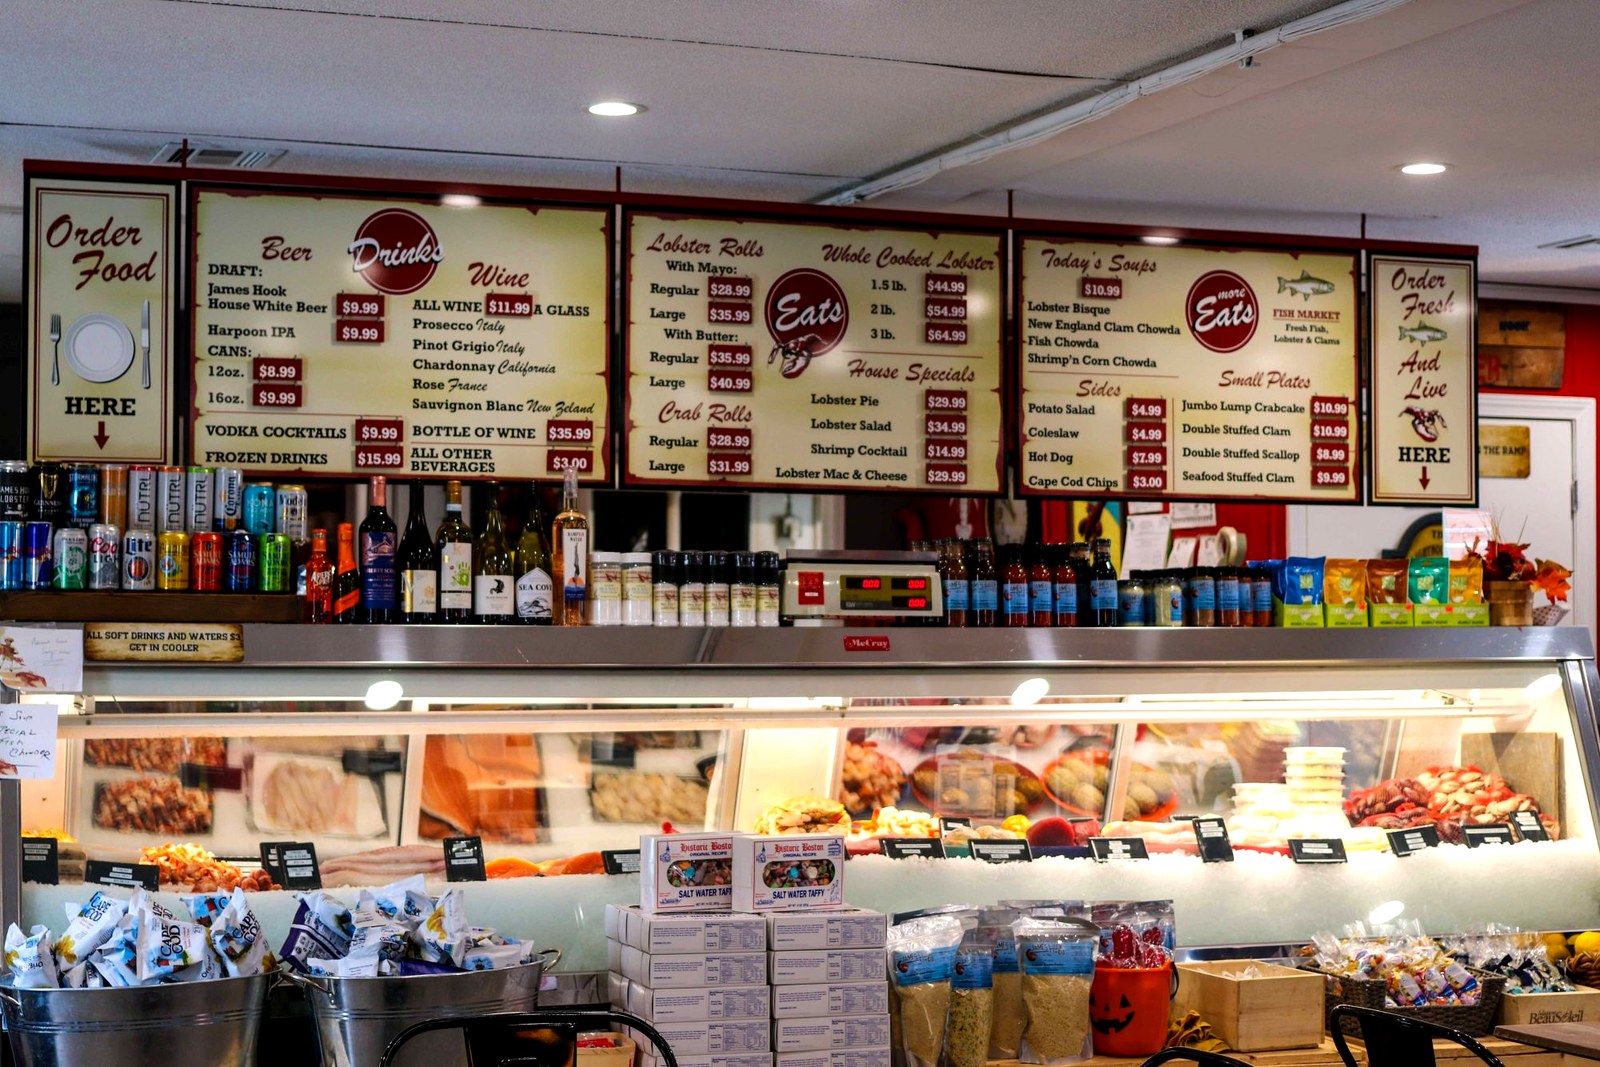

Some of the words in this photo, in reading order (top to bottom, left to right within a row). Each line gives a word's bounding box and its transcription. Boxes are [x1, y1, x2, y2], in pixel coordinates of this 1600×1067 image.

[46, 214, 142, 248] Order
[261, 236, 312, 261] Beer
[348, 232, 446, 272] Drinks
[647, 233, 711, 254] Lobster
[719, 238, 764, 257] Rolls
[822, 245, 871, 264] Whole
[877, 247, 932, 268] Cooked
[937, 251, 996, 270] Lobster
[1041, 249, 1101, 273] Today's
[1109, 254, 1157, 276] Soups
[72, 251, 157, 290] Food
[208, 264, 262, 277] DRAFT:
[468, 262, 529, 288] Wine
[666, 260, 694, 273] With
[698, 263, 737, 276] Mayo:
[1391, 267, 1446, 291] Order
[208, 284, 248, 297] James
[253, 284, 286, 296] Hook
[650, 283, 699, 296] Regular
[711, 284, 750, 296] $28.99
[927, 281, 965, 292] $44.99
[1085, 284, 1120, 296] $10.99
[1218, 287, 1246, 300] more
[208, 299, 250, 312] House
[253, 300, 291, 312] White
[343, 301, 378, 315] $9.99
[444, 301, 482, 312] WINE
[489, 301, 530, 315] $11.99
[547, 305, 589, 317] GLASS
[775, 293, 843, 332] Eats
[1028, 302, 1069, 313] Lobster
[1073, 303, 1110, 316] Bisque
[1401, 291, 1455, 321] Fresh
[650, 308, 686, 321] Large
[710, 309, 750, 321] $35.99
[1195, 296, 1255, 333] Eats
[1273, 309, 1294, 318] FISH
[1298, 310, 1340, 319] MARKET
[208, 325, 268, 339] Harpoon
[271, 326, 295, 338] IPA
[413, 319, 473, 331] Prosecco
[476, 318, 505, 334] Italy
[1028, 319, 1053, 330] New
[1056, 320, 1101, 333] England
[1104, 322, 1134, 333] Clam
[1137, 324, 1180, 335] Chowda
[1286, 324, 1307, 332] Fresh
[1310, 324, 1328, 334] Fish,
[696, 330, 738, 343] Butter:
[1028, 336, 1051, 346] Fish
[1274, 335, 1303, 344] Lobster
[1315, 337, 1340, 345] Clams
[208, 345, 252, 358] CANS:
[413, 340, 448, 351] Pinot
[452, 341, 495, 354] Grigio
[413, 359, 495, 374] Chardonnay
[498, 360, 556, 376] California
[1082, 356, 1110, 366] Corn
[1398, 351, 1441, 375] And
[208, 365, 244, 378] 12oz.
[259, 365, 296, 379] $8.99
[848, 359, 898, 379] House
[905, 363, 976, 384] Specials
[413, 379, 445, 390] Rose
[447, 378, 487, 392] France
[1219, 370, 1264, 387] Small
[1267, 371, 1311, 389] Plates
[1076, 380, 1121, 397] Sides
[1404, 376, 1447, 400] Live
[65, 397, 136, 416] HERE
[413, 399, 482, 413] Sauvignon
[486, 400, 523, 412] Blanc
[527, 400, 551, 413] New
[928, 397, 965, 409] $29.99
[1029, 404, 1063, 414] Potato
[1066, 404, 1095, 415] Salad
[1132, 405, 1161, 416] $4.99
[1183, 401, 1218, 412] Jumbo
[1220, 402, 1252, 413] Lump
[1255, 404, 1305, 413] Crabcake
[659, 400, 703, 424] Crab
[811, 419, 856, 430] Lobster
[1183, 424, 1220, 434] Double
[1223, 425, 1259, 435] Stuffed
[1263, 426, 1291, 436] Clam
[1314, 426, 1347, 437] $10.99
[206, 425, 259, 438] VODKA
[263, 426, 346, 439] COCKTAILS
[413, 426, 470, 437] BOTTLE
[549, 426, 591, 440] $35.99
[1029, 428, 1079, 439] Coleslaw
[206, 451, 266, 464] FROZEN
[270, 452, 327, 464] DRINKS
[358, 452, 401, 465] $15.99
[811, 444, 855, 458] Shrimp
[858, 446, 907, 457] Cocktail
[1262, 450, 1300, 462] Scallop
[1317, 449, 1345, 460] $8.99
[1398, 447, 1450, 463] HERE
[411, 461, 495, 473] BEVERAGES
[865, 470, 907, 481] Cheese
[1029, 476, 1058, 487] Cape
[1061, 477, 1083, 487] Cod
[1086, 477, 1118, 489] Chips
[1133, 477, 1162, 488] $3.00
[1183, 472, 1224, 482] Seafood
[1317, 473, 1345, 484] $9.99
[105, 632, 129, 640] SOFT
[131, 632, 165, 640] DRINKS
[167, 632, 186, 640] AND
[680, 844, 707, 852] Historic
[775, 844, 799, 853] Historic
[696, 888, 717, 896] WATER
[773, 891, 786, 899] SALT
[788, 890, 807, 898] WATER
[808, 889, 825, 897] TAFFY
[91, 896, 110, 913] CAPE
[84, 908, 102, 922] COD
[232, 910, 256, 938] CAPE
[161, 924, 171, 956] CAPE
[168, 925, 183, 954] COD
